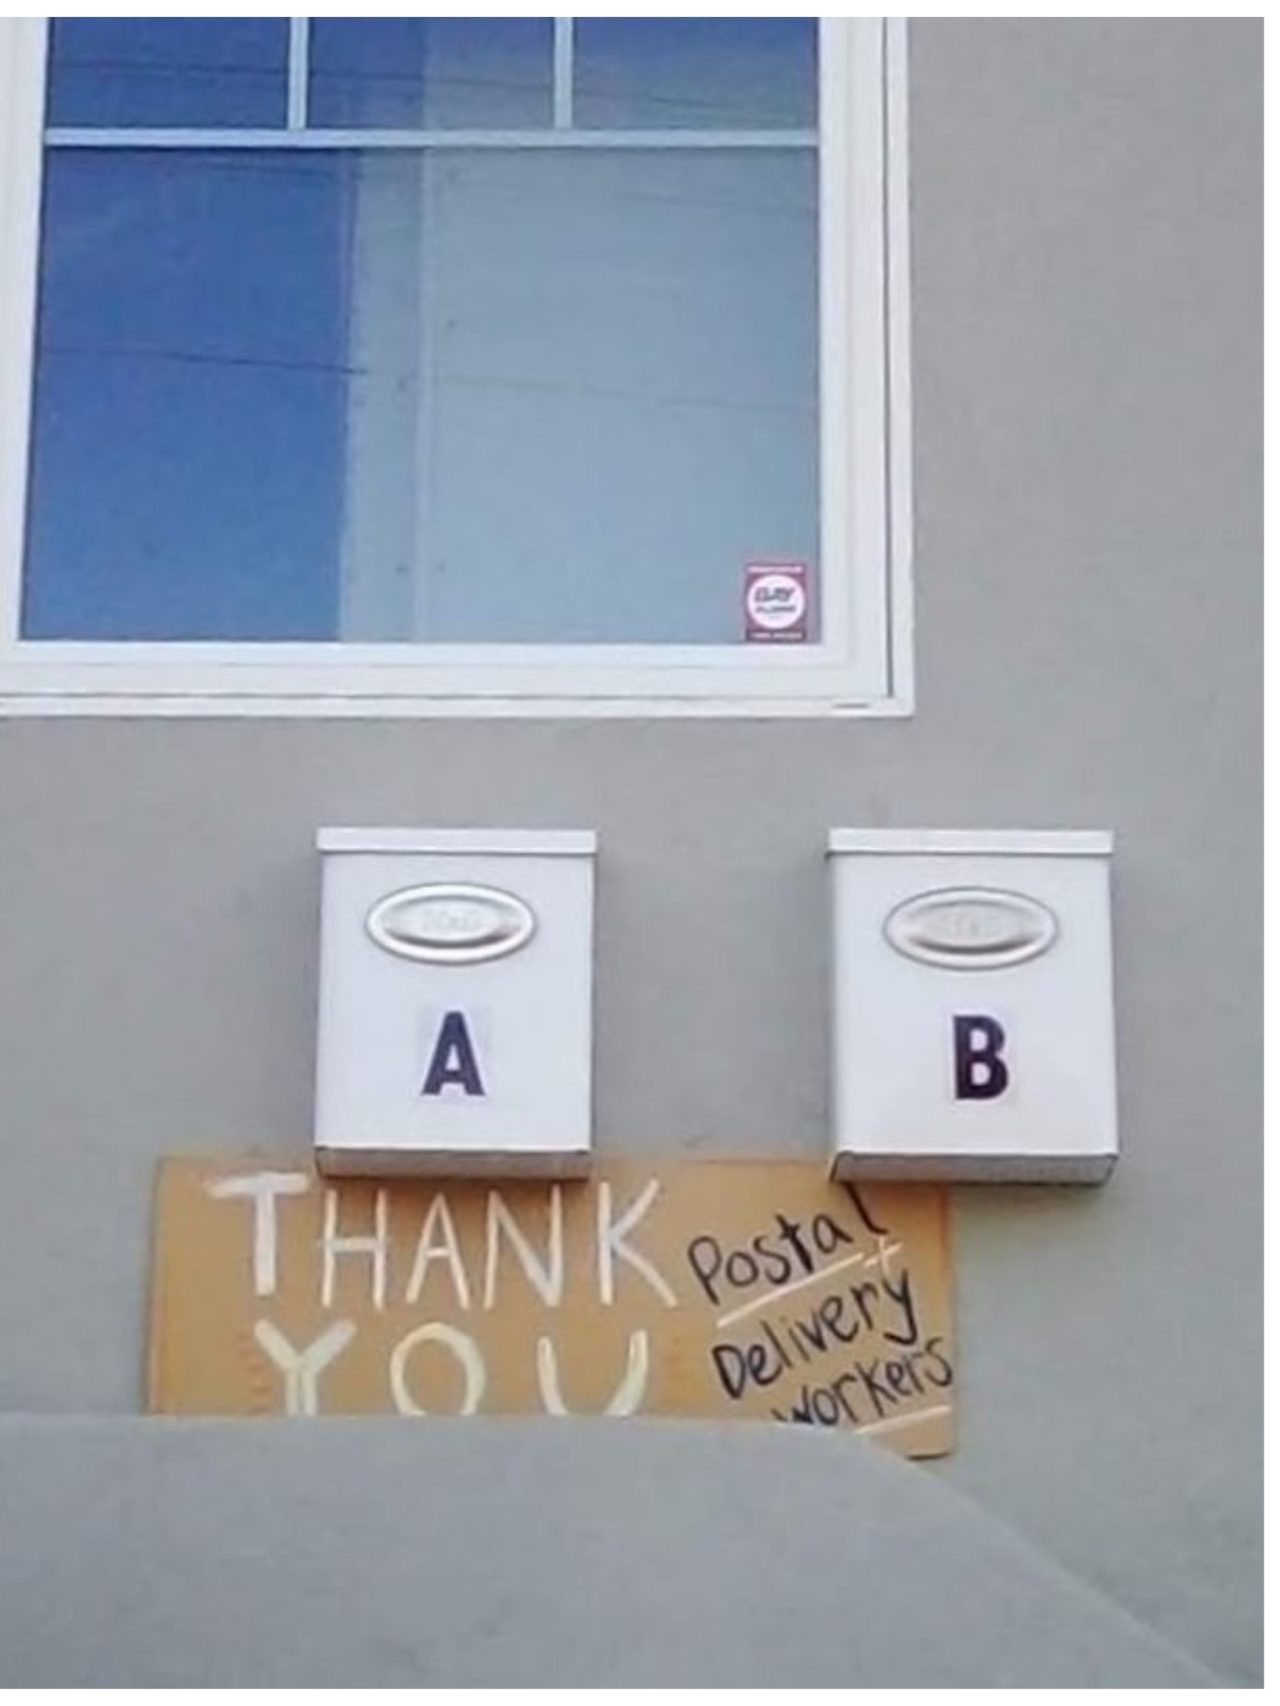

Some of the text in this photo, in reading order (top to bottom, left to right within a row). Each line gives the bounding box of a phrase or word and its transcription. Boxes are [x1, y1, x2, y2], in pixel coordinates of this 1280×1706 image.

[420, 1010, 486, 1096] A
[952, 1014, 1010, 1100] B
[207, 1171, 678, 1310] THANK
[687, 1180, 888, 1306] Postal
[254, 1319, 649, 1416] YOU
[711, 1268, 918, 1400] Delivery
